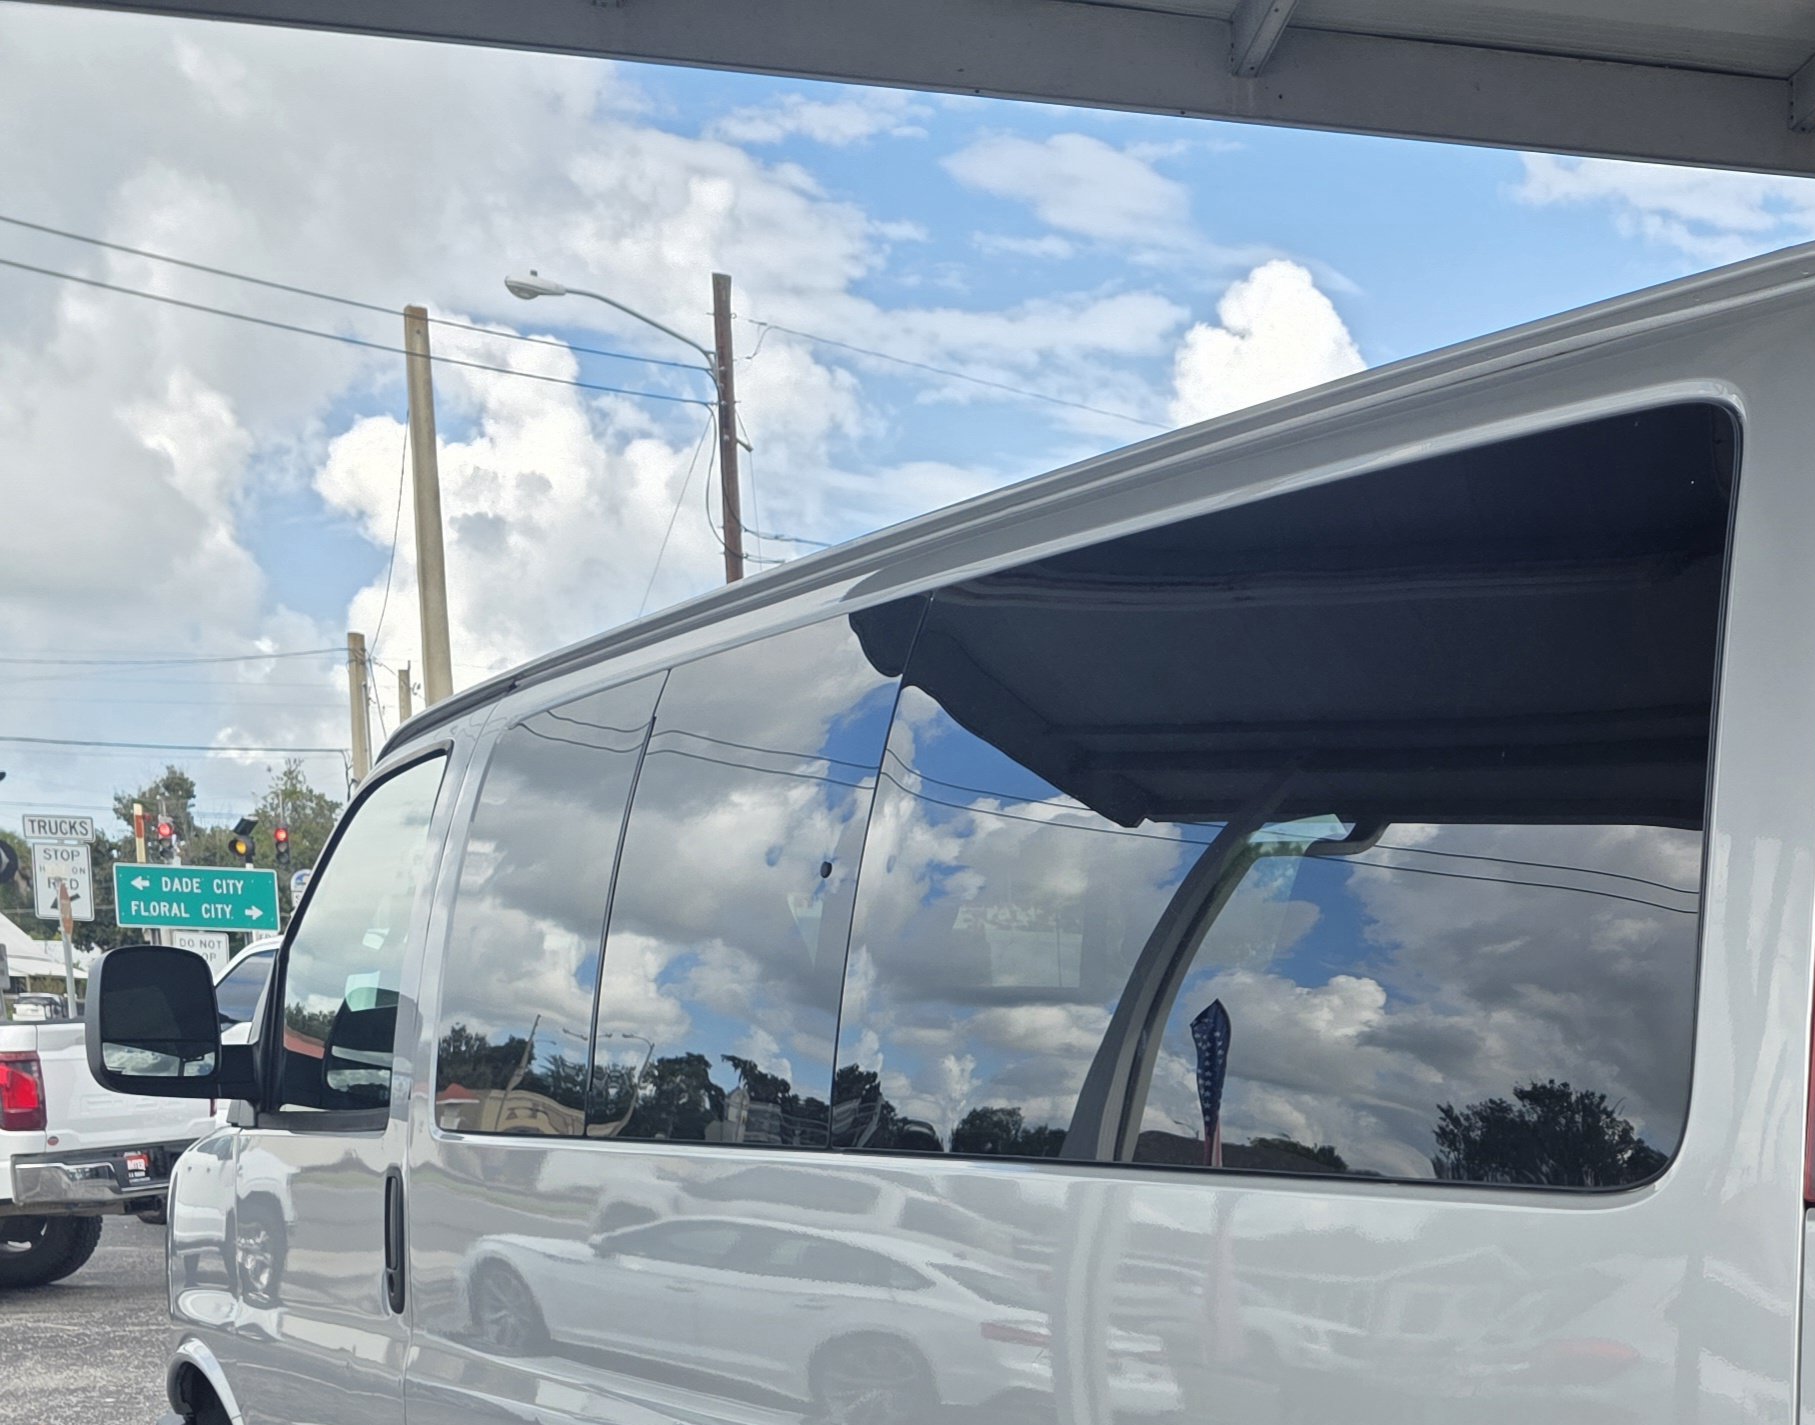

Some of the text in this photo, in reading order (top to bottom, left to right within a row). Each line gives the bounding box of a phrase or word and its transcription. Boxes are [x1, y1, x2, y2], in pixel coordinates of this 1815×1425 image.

[28, 819, 89, 836] TRUCKS
[43, 847, 81, 861] STOP
[161, 876, 244, 895] DADE CITY
[131, 901, 233, 919] FLORAL CITY
[179, 937, 223, 950] DO NOT
